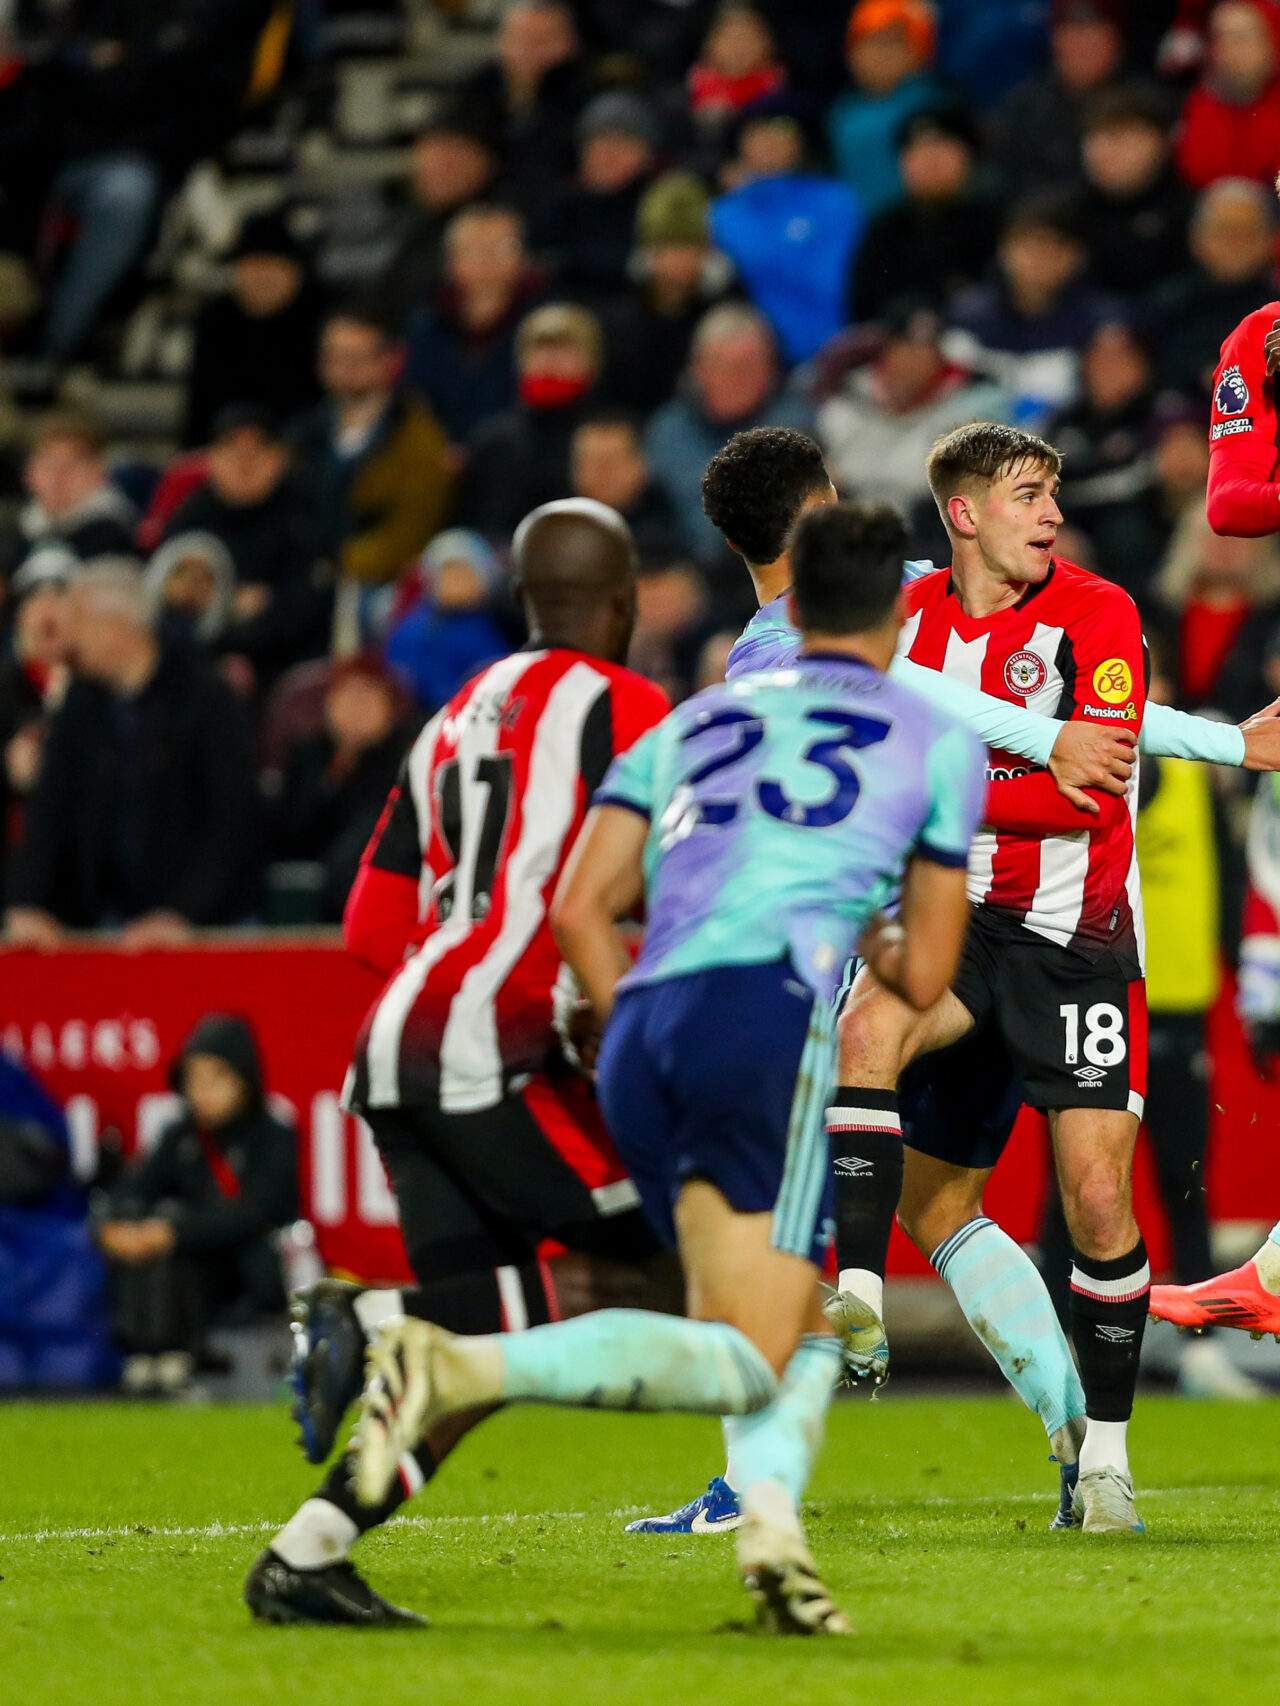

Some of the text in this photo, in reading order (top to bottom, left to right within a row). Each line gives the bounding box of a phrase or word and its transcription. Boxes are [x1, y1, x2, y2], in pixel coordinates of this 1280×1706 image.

[1225, 417, 1250, 429] room
[1223, 424, 1253, 437] racism
[673, 710, 893, 828] 23
[1059, 1002, 1127, 1067] 18
[1077, 1079, 1103, 1088] umbro
[833, 1169, 874, 1177] umbro
